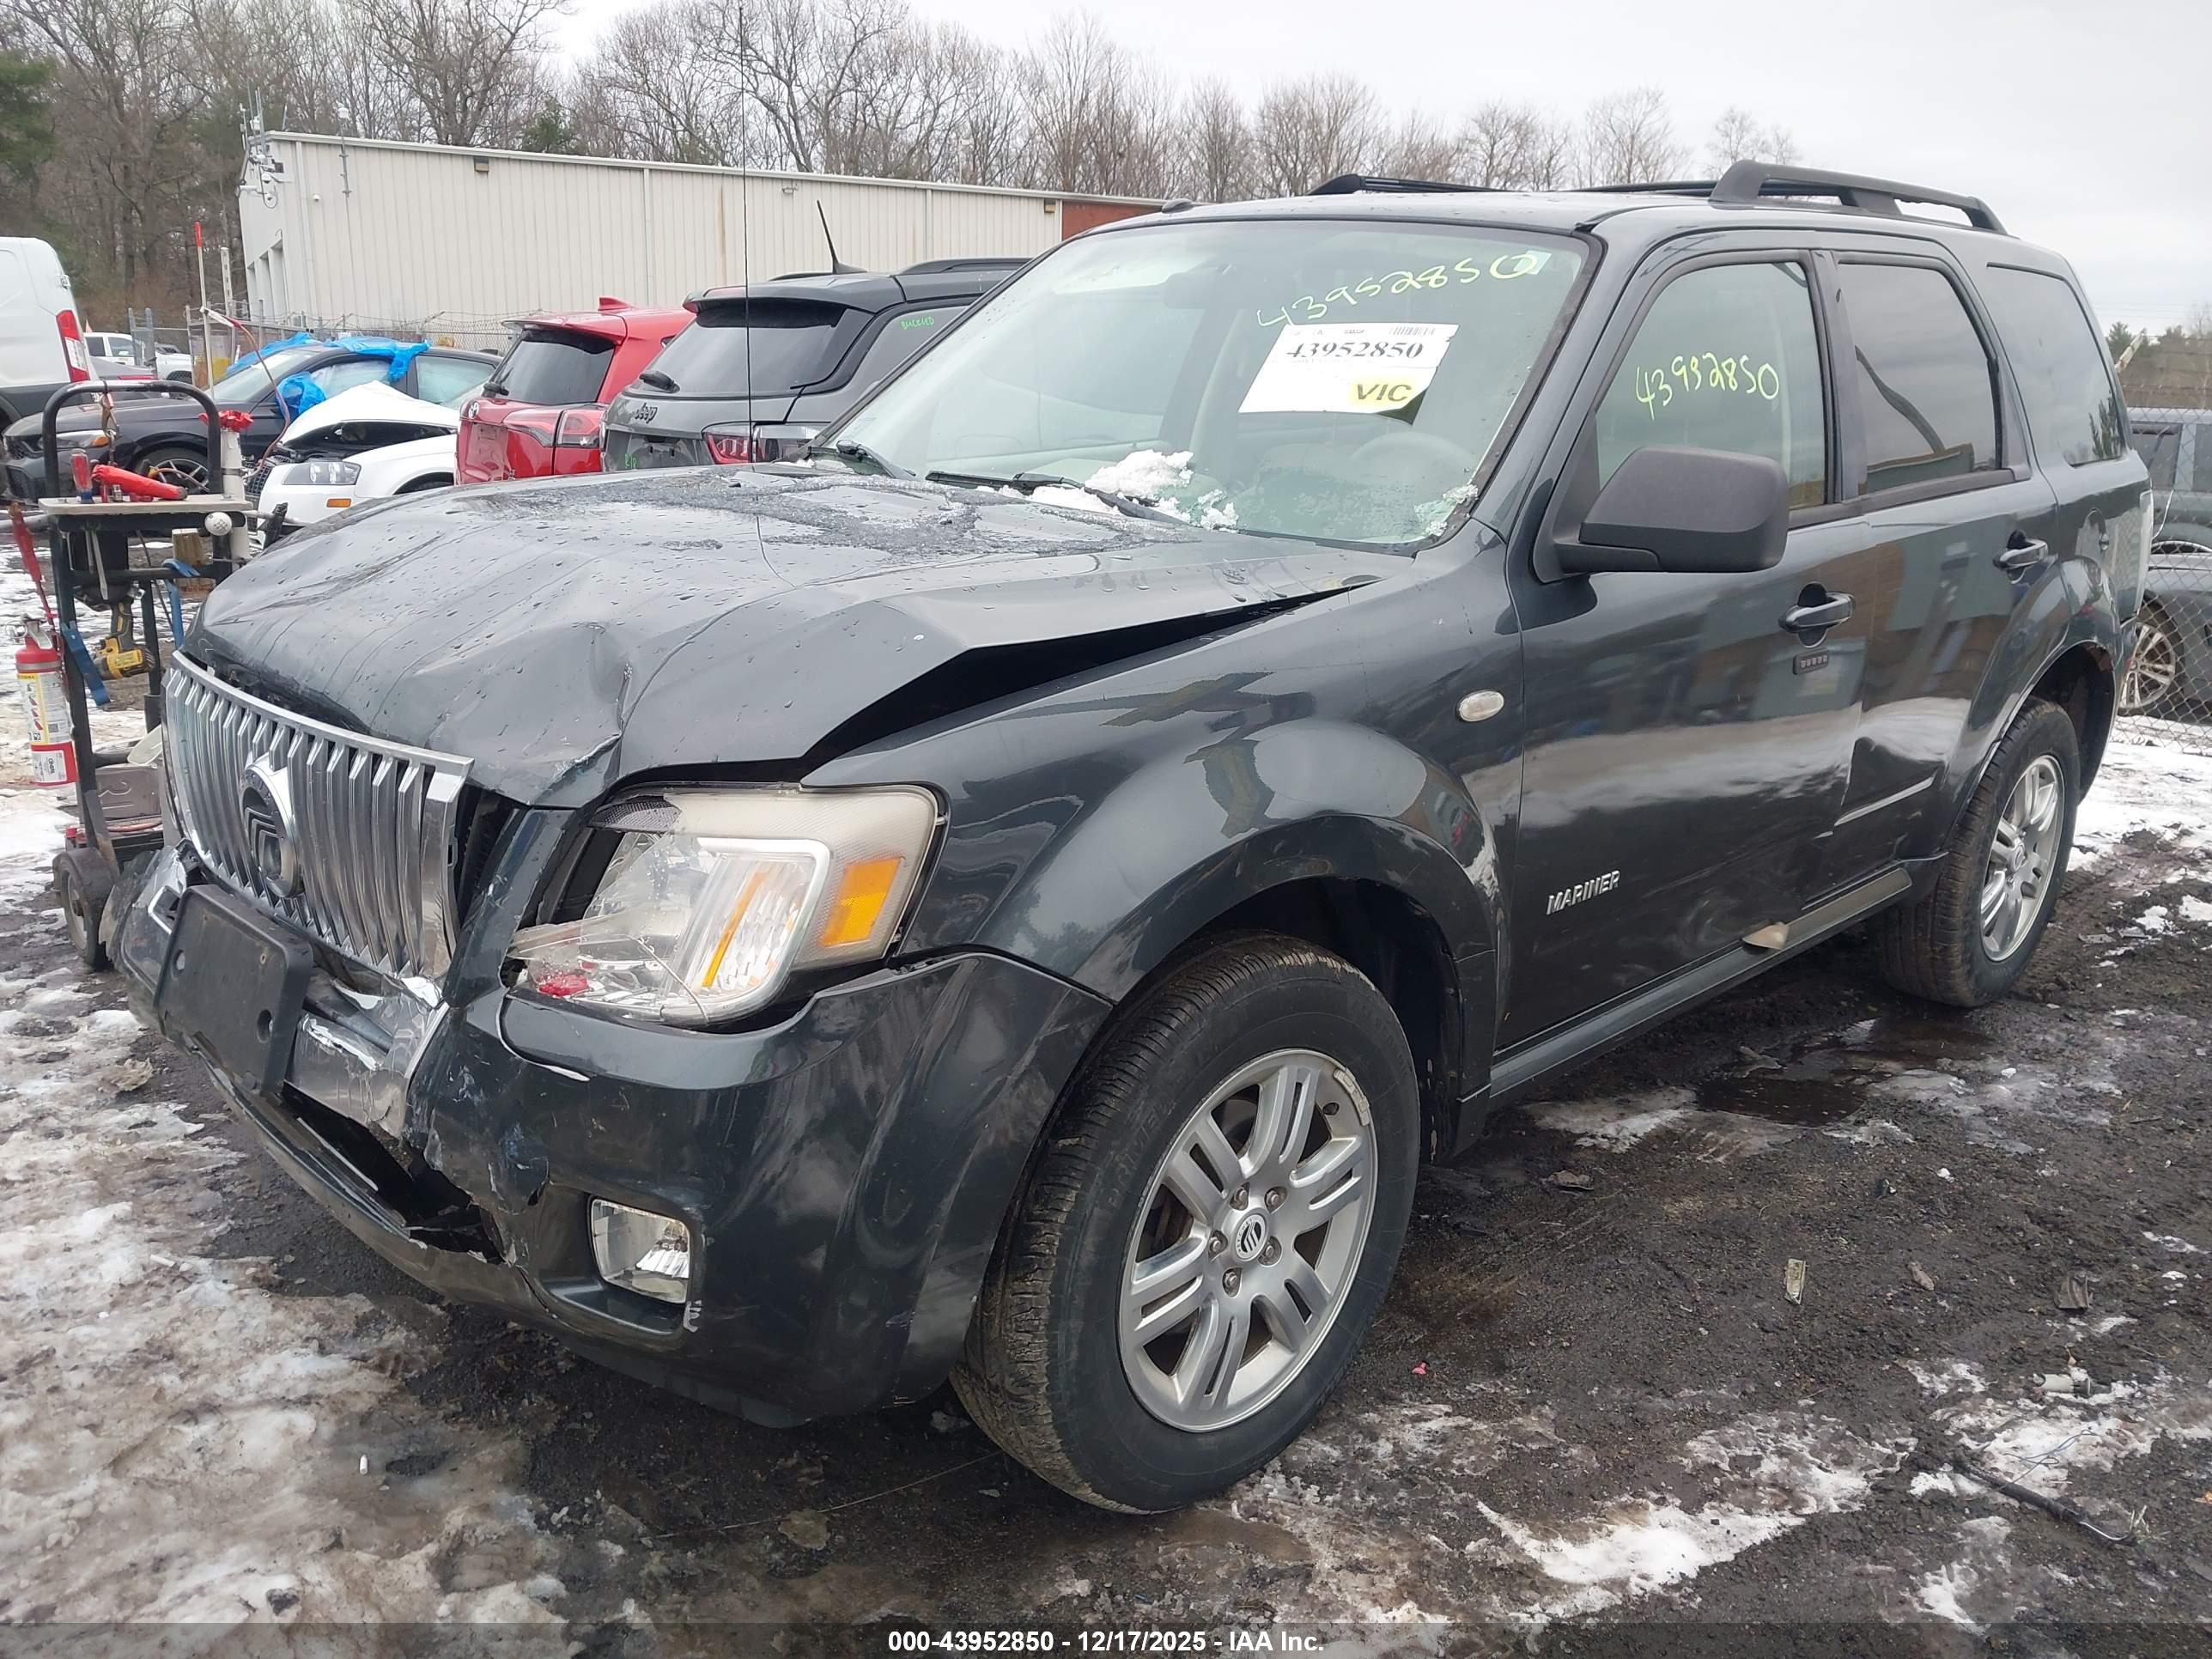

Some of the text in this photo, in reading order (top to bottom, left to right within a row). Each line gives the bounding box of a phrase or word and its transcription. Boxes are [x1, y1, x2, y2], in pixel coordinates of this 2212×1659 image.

[1256, 253, 1540, 328] 43952850
[1286, 342, 1424, 358] 43952850
[1355, 382, 1413, 403] VIC
[634, 402, 658, 423] Jeep
[1546, 869, 1621, 915] MARINER
